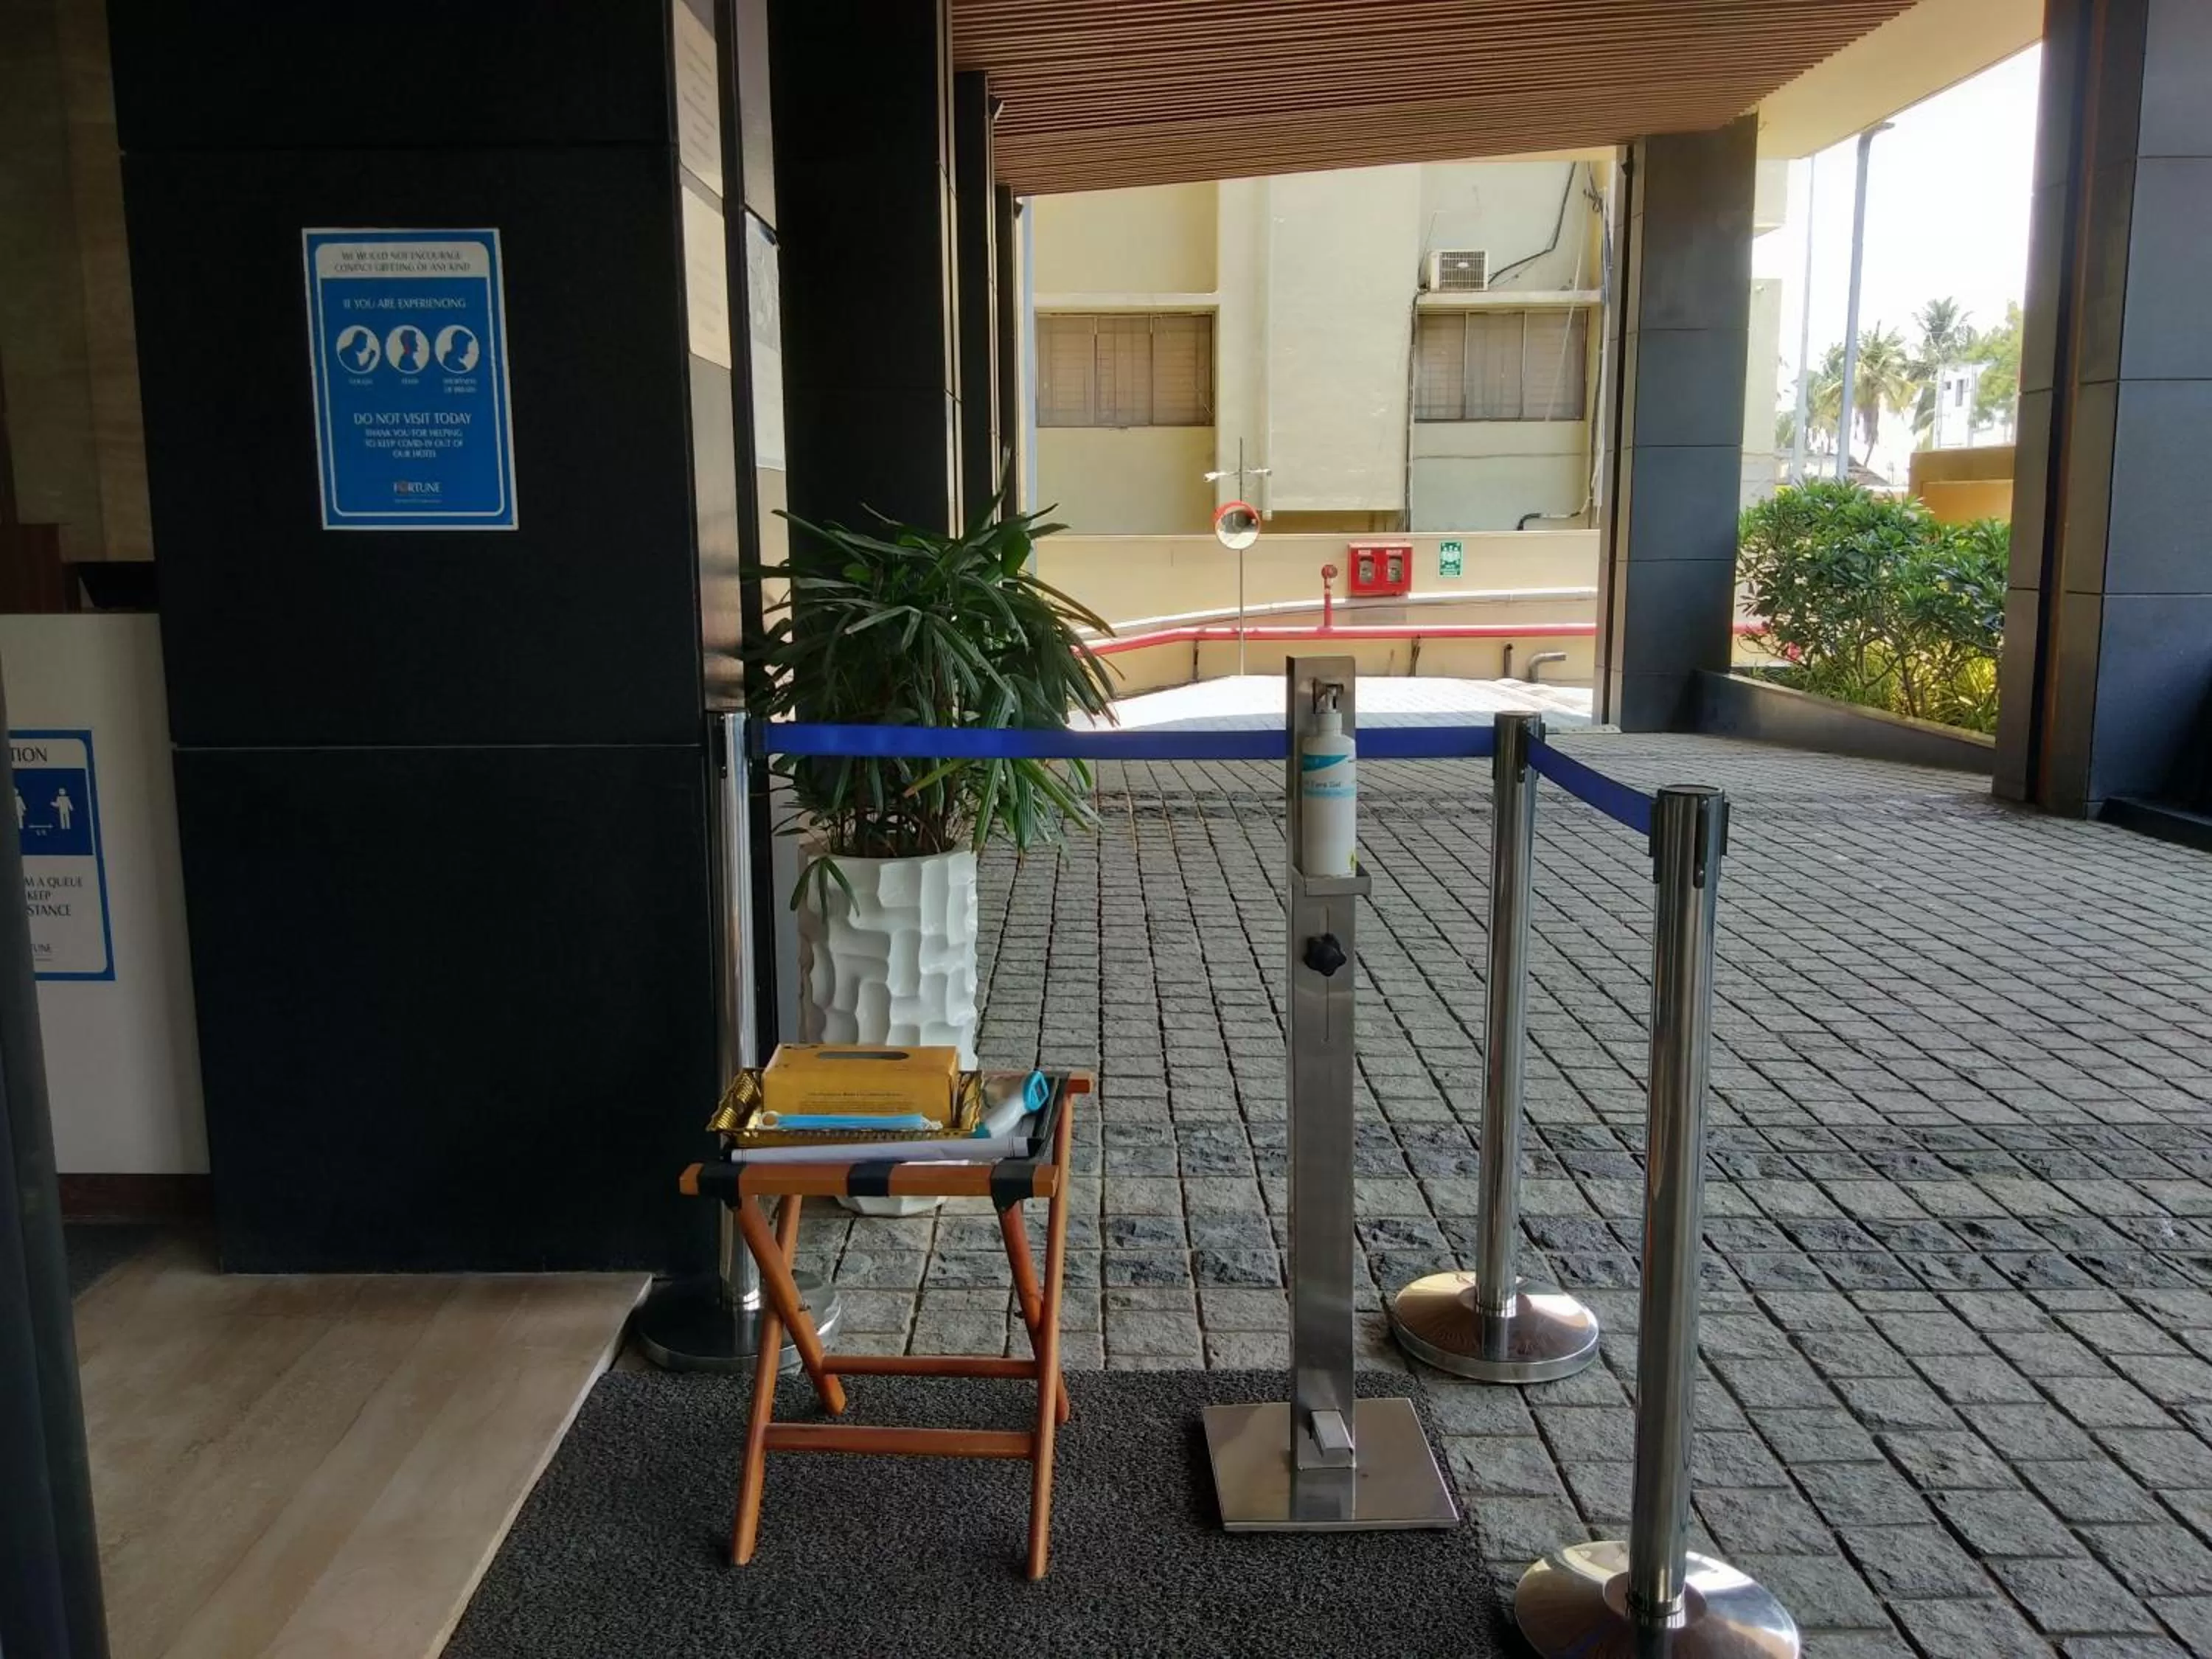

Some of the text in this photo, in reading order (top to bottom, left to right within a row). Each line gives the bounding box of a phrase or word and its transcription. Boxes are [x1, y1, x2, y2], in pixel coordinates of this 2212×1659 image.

[353, 298, 375, 309] YOU
[377, 298, 396, 309] ARE
[397, 297, 467, 309] EXPERIENCING
[354, 412, 473, 425] DO NOT VISIT TODAY
[365, 428, 390, 437] THANK
[392, 428, 408, 437] YOU
[411, 428, 428, 437] FOR
[392, 481, 442, 494] FORTUNE
[11, 746, 48, 762] TION
[36, 876, 45, 887] A
[46, 876, 83, 888] QUEUE
[27, 890, 52, 900] KEEP
[26, 904, 72, 917] STANCE
